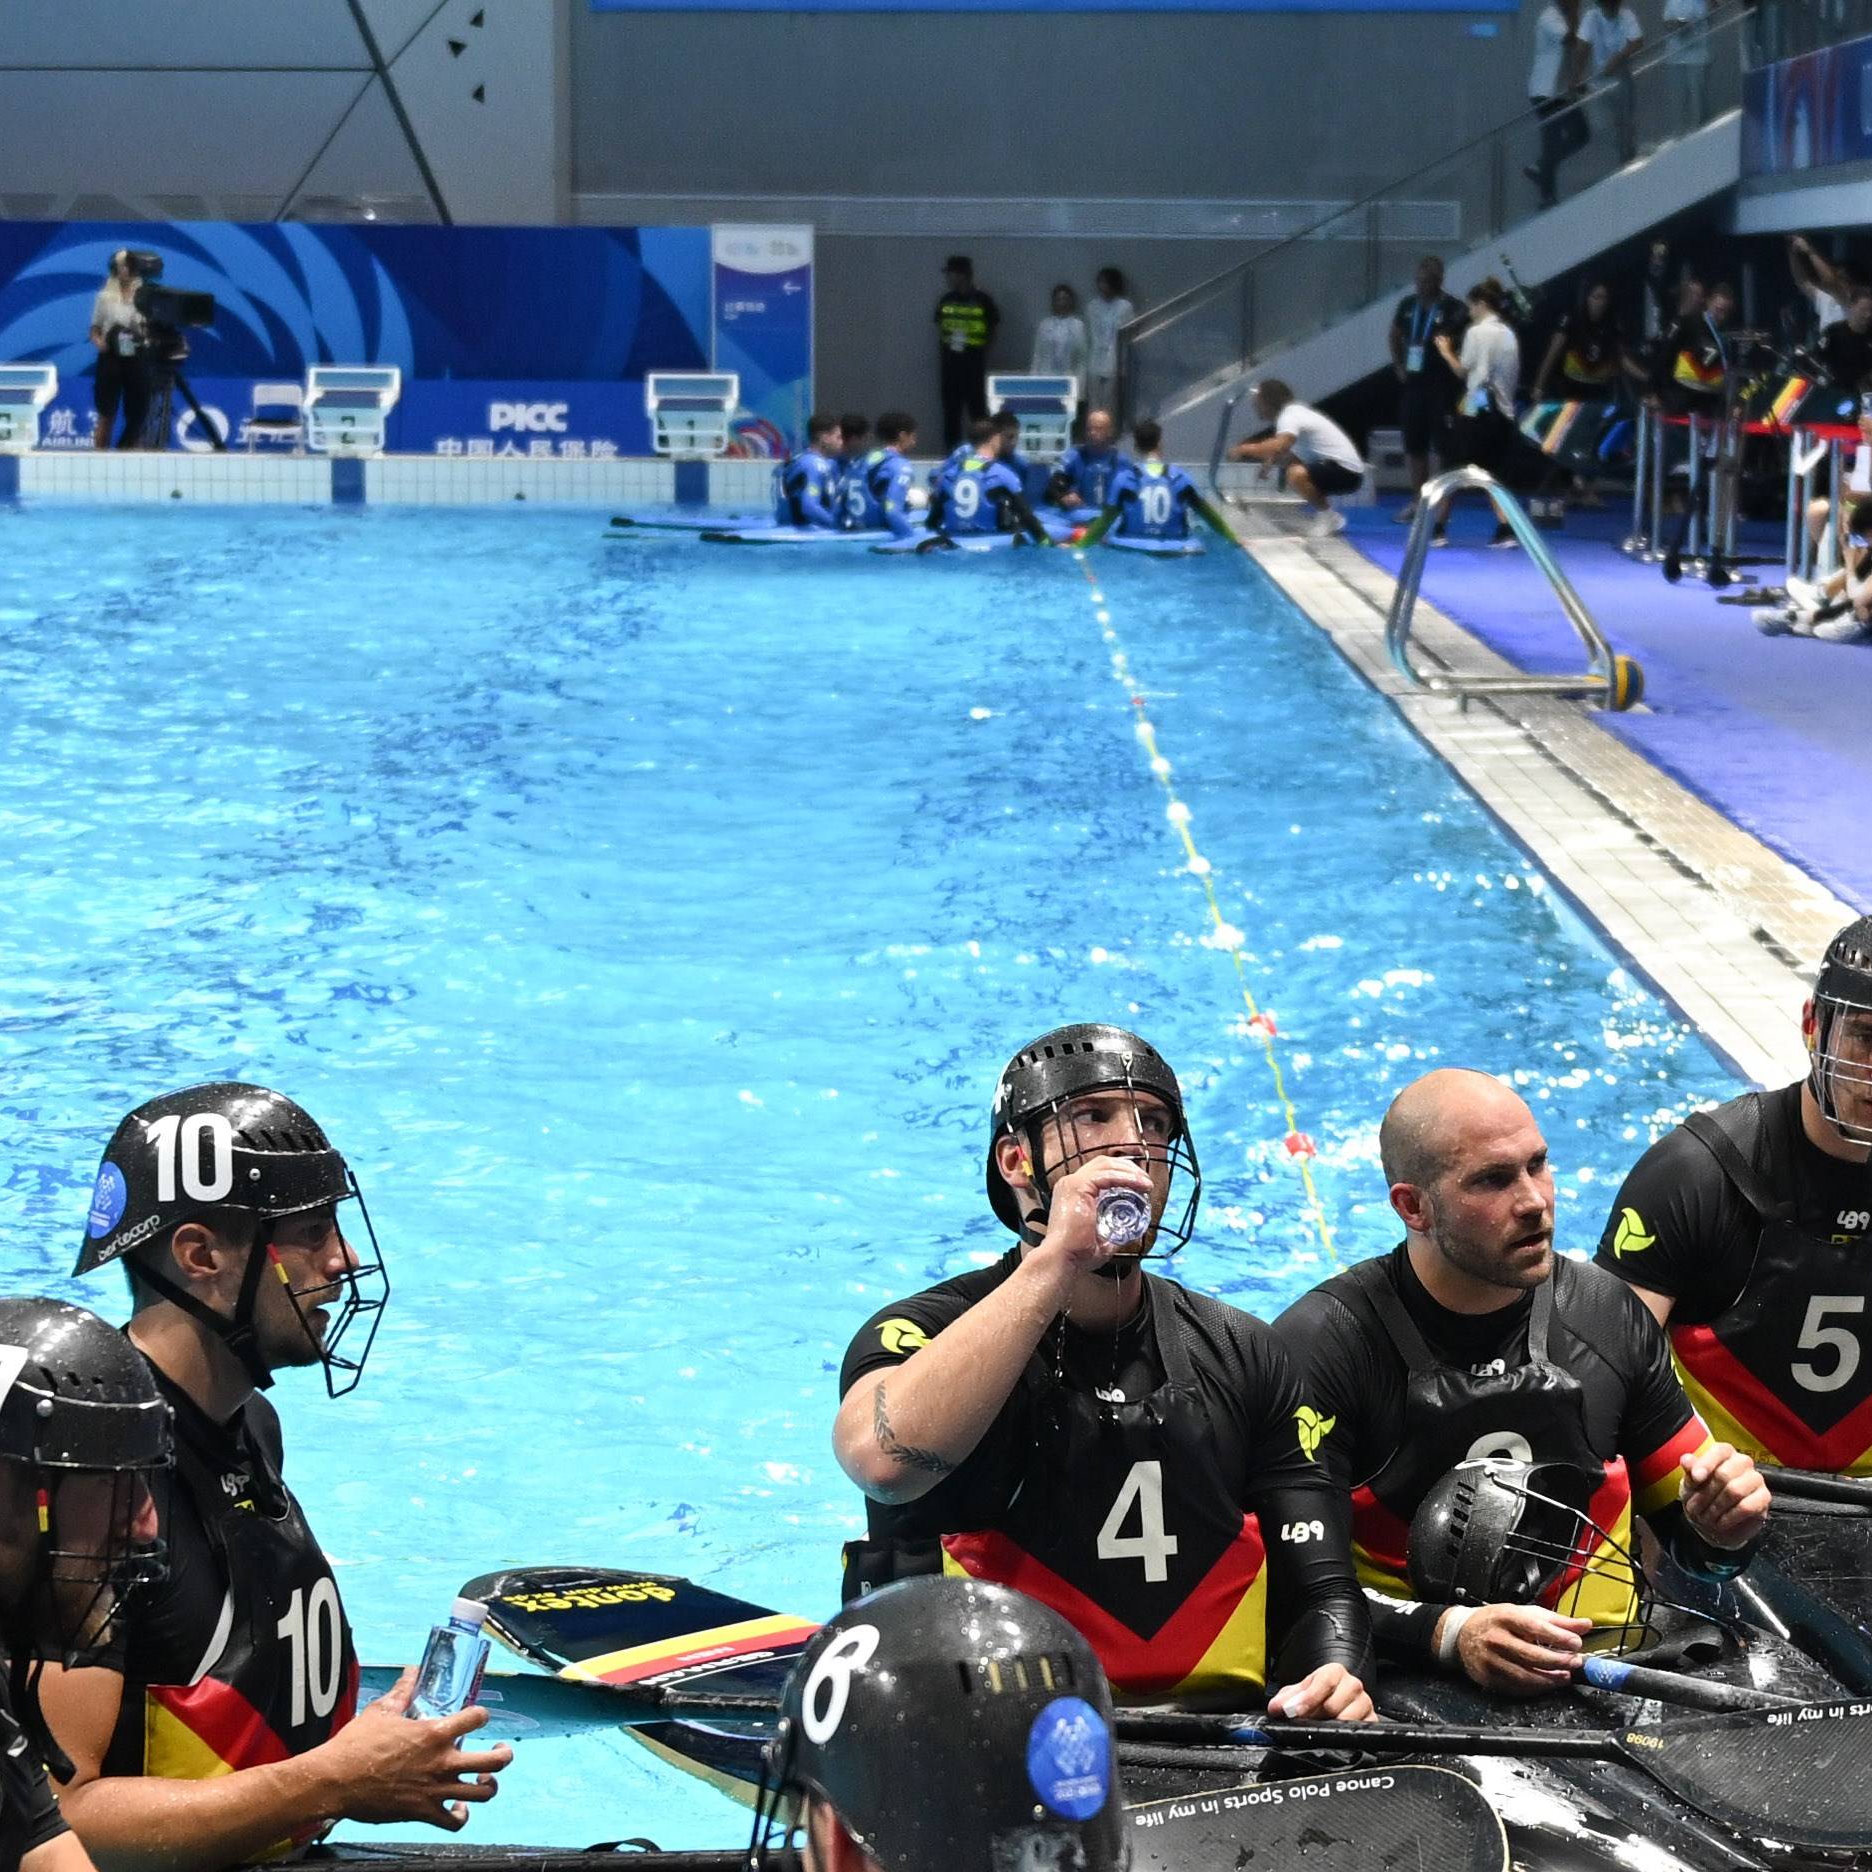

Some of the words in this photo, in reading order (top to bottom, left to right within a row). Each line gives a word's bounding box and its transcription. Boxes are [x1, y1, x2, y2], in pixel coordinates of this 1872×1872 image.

[489, 403, 568, 432] PICC
[848, 479, 867, 516] 5
[953, 479, 979, 518] 9
[1138, 485, 1171, 525] 10
[145, 1112, 233, 1203] 10
[1790, 1295, 1866, 1393] 5
[1096, 1460, 1178, 1583] 4
[511, 1585, 677, 1613] dontex
[276, 1576, 343, 1728] 10
[1767, 1711, 1793, 1726] life
[1797, 1707, 1825, 1723] my
[1829, 1704, 1848, 1719] in
[1289, 1781, 1331, 1800] Polo
[1336, 1775, 1395, 1792] Canoe
[1168, 1802, 1198, 1821] my
[1202, 1797, 1220, 1814] in
[1224, 1788, 1285, 1811] Sports
[1134, 1809, 1164, 1827] life
